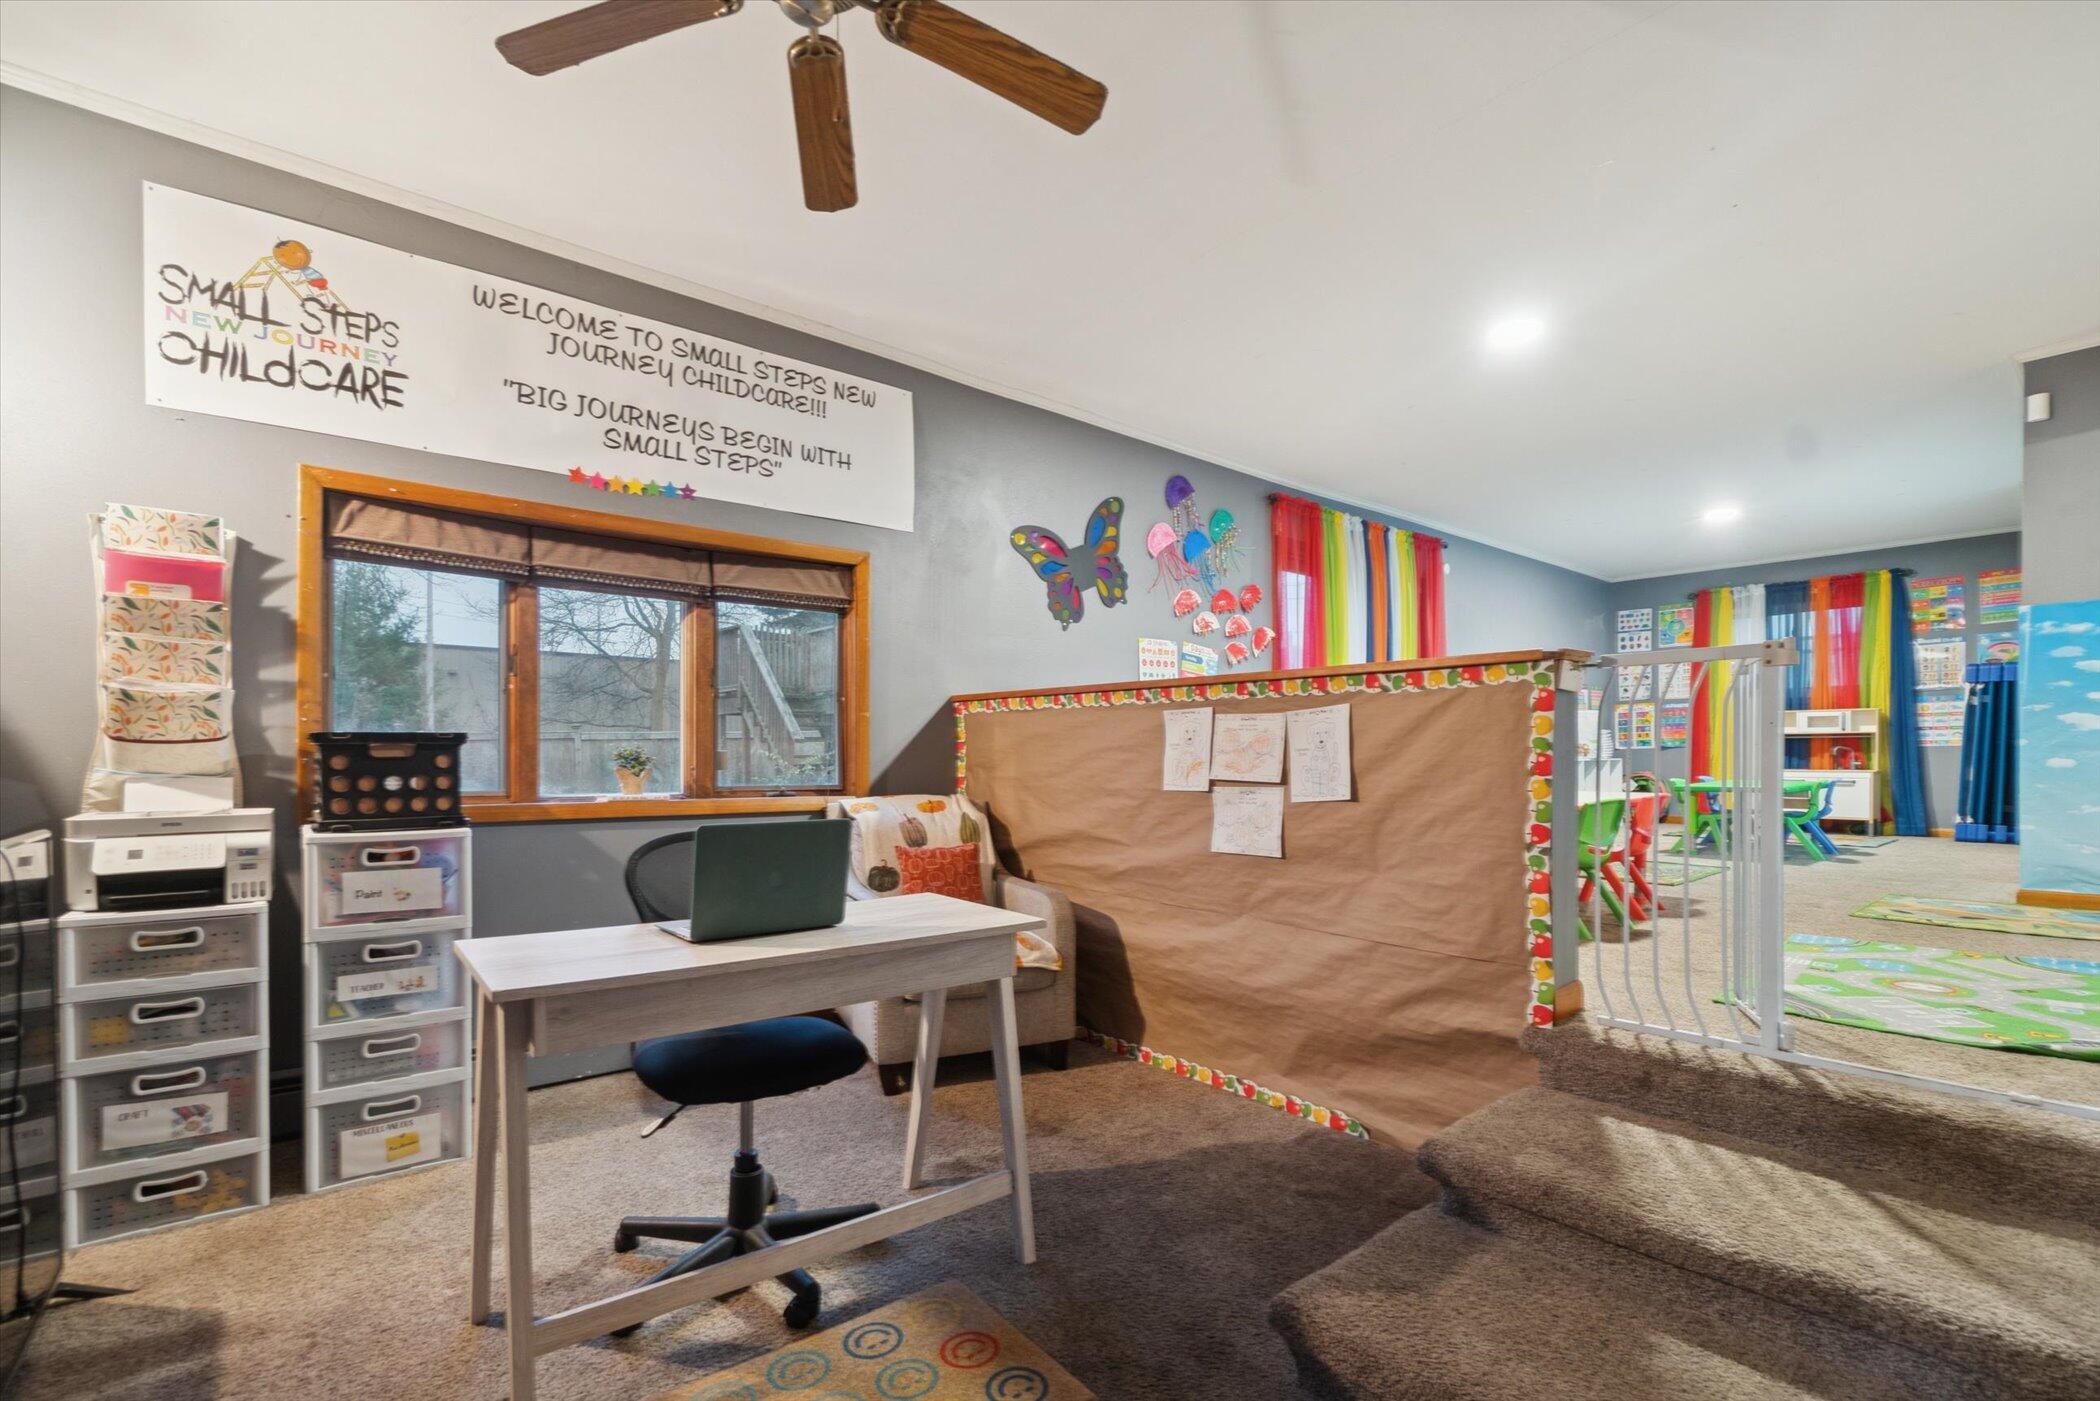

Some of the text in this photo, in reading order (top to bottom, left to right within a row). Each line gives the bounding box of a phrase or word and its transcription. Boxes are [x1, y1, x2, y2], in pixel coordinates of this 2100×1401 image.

[158, 264, 400, 348] SMALL STEPS
[165, 306, 397, 367] NEW JOURNEY
[472, 284, 876, 408] WELCOME TO SMALL STEPS NEW
[546, 332, 827, 418] JOURNEY CHILDCARE!!!
[503, 378, 852, 471] "BIG JOURNEYS BEGIN WITH
[603, 428, 782, 478] SMALL STEPS"
[355, 889, 382, 899] Paint
